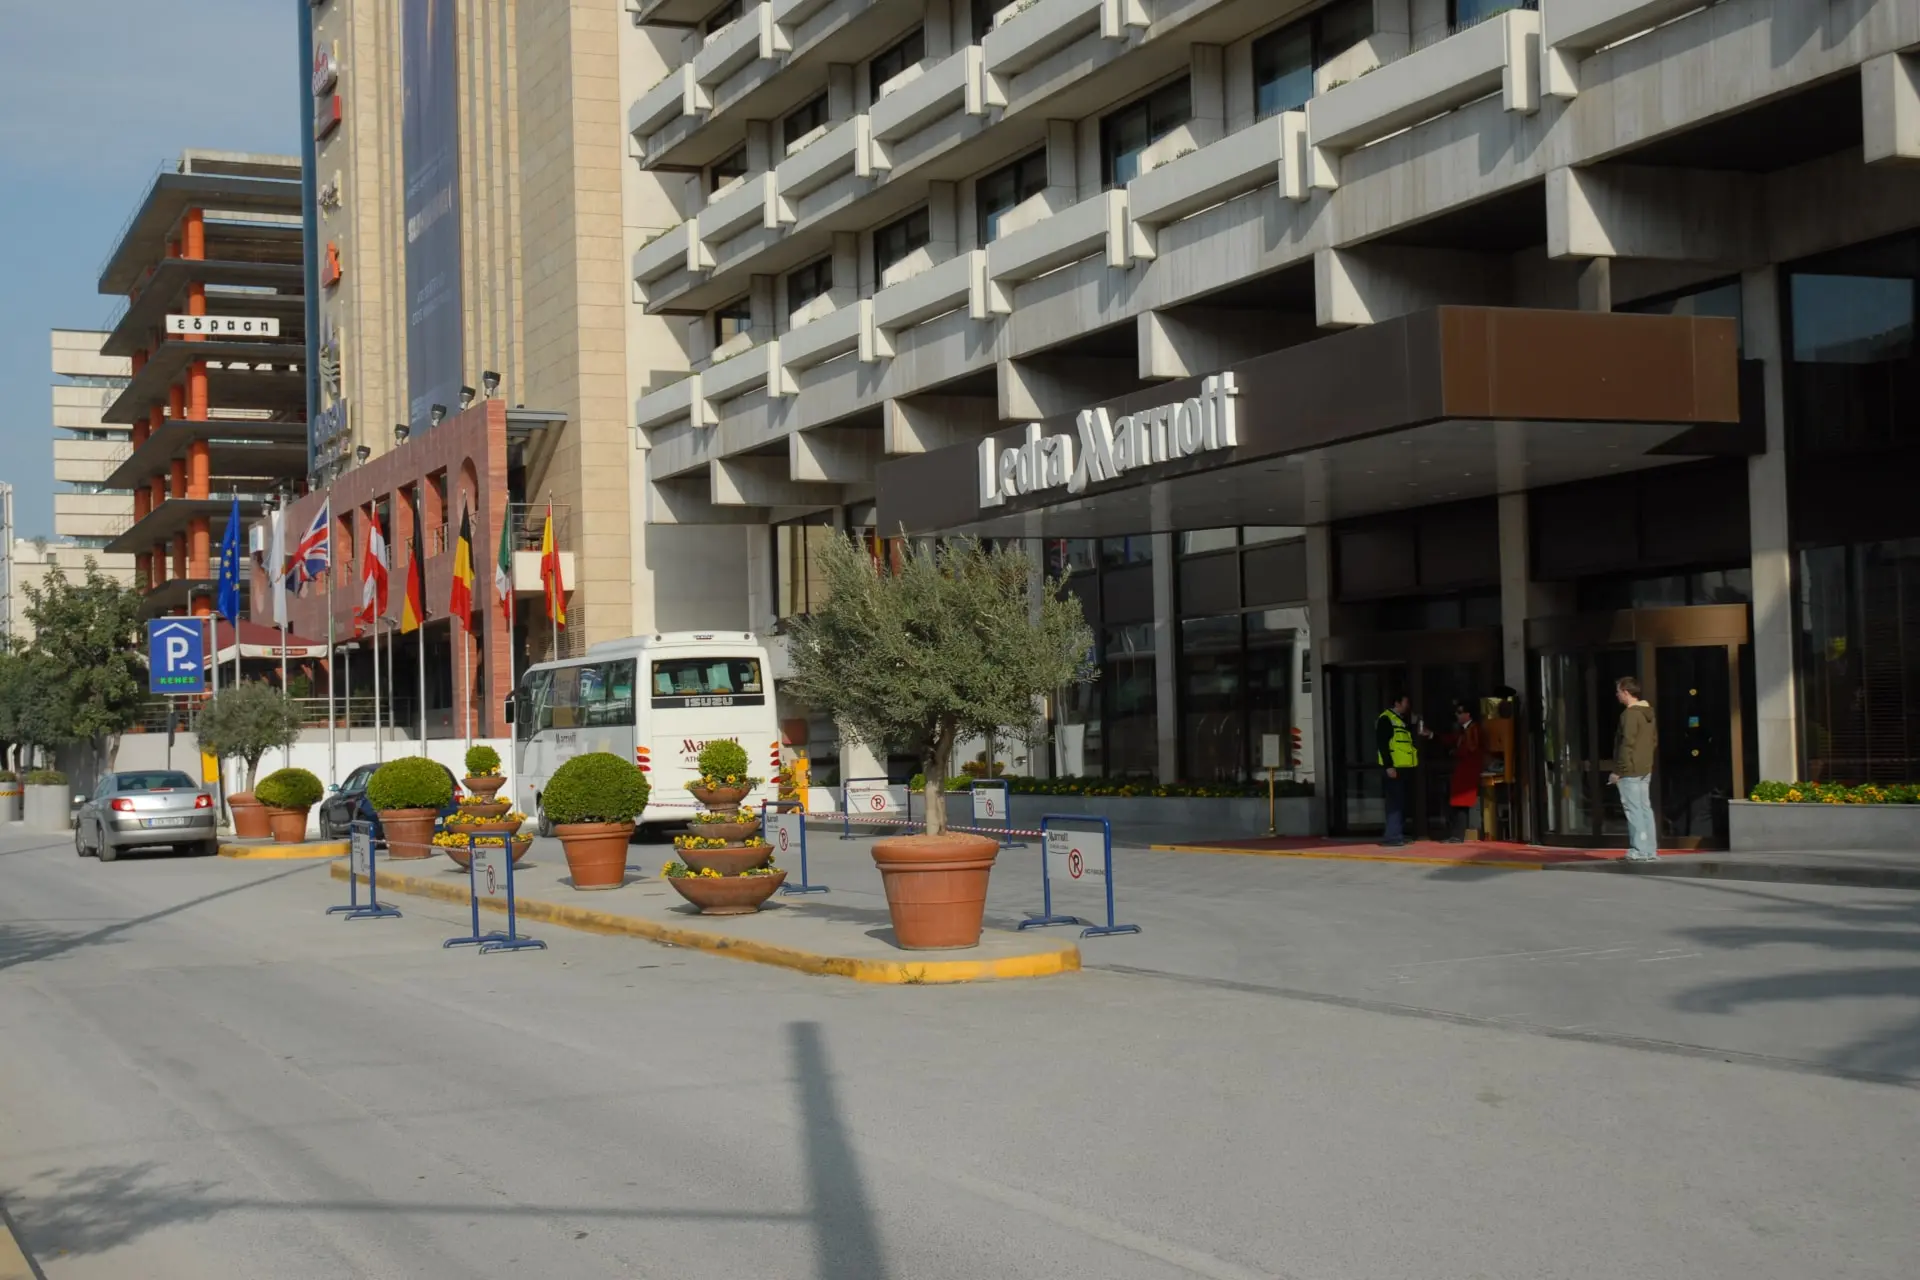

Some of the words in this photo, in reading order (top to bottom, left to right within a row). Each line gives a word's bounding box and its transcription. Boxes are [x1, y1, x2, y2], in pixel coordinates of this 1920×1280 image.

[978, 422, 1074, 508] Ledra
[1067, 371, 1239, 494] Marriott
[166, 636, 189, 672] P
[684, 697, 734, 707] ISUZU
